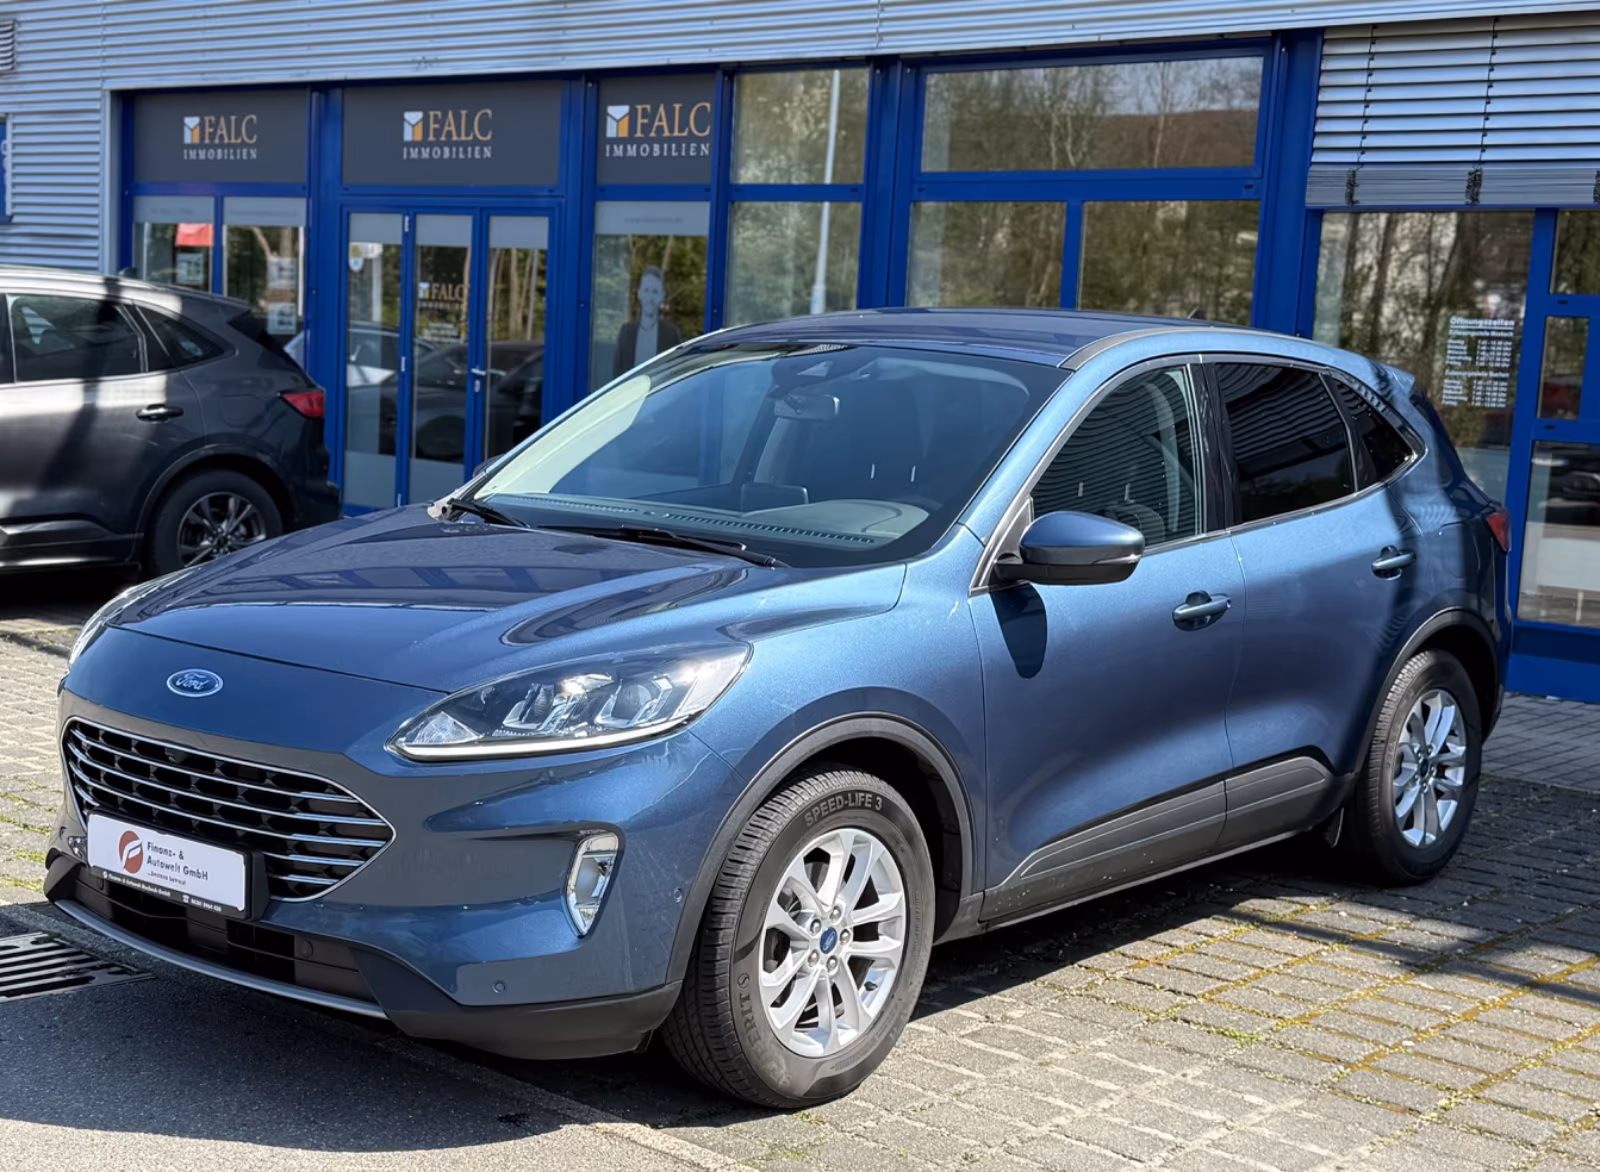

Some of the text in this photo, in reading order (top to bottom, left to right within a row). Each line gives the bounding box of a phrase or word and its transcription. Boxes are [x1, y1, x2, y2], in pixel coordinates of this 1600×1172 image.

[428, 108, 492, 141] FALC
[634, 102, 711, 137] FALC
[204, 114, 257, 144] FALC
[183, 148, 257, 160] IMMOBILIEN
[403, 146, 492, 160] IMMOBILIEN
[605, 143, 710, 157] IMMOBILIEN
[175, 672, 210, 690] Ford
[875, 796, 883, 811] 3
[147, 841, 185, 860] Finanz- &
[147, 855, 208, 881] Autowelt GmbH
